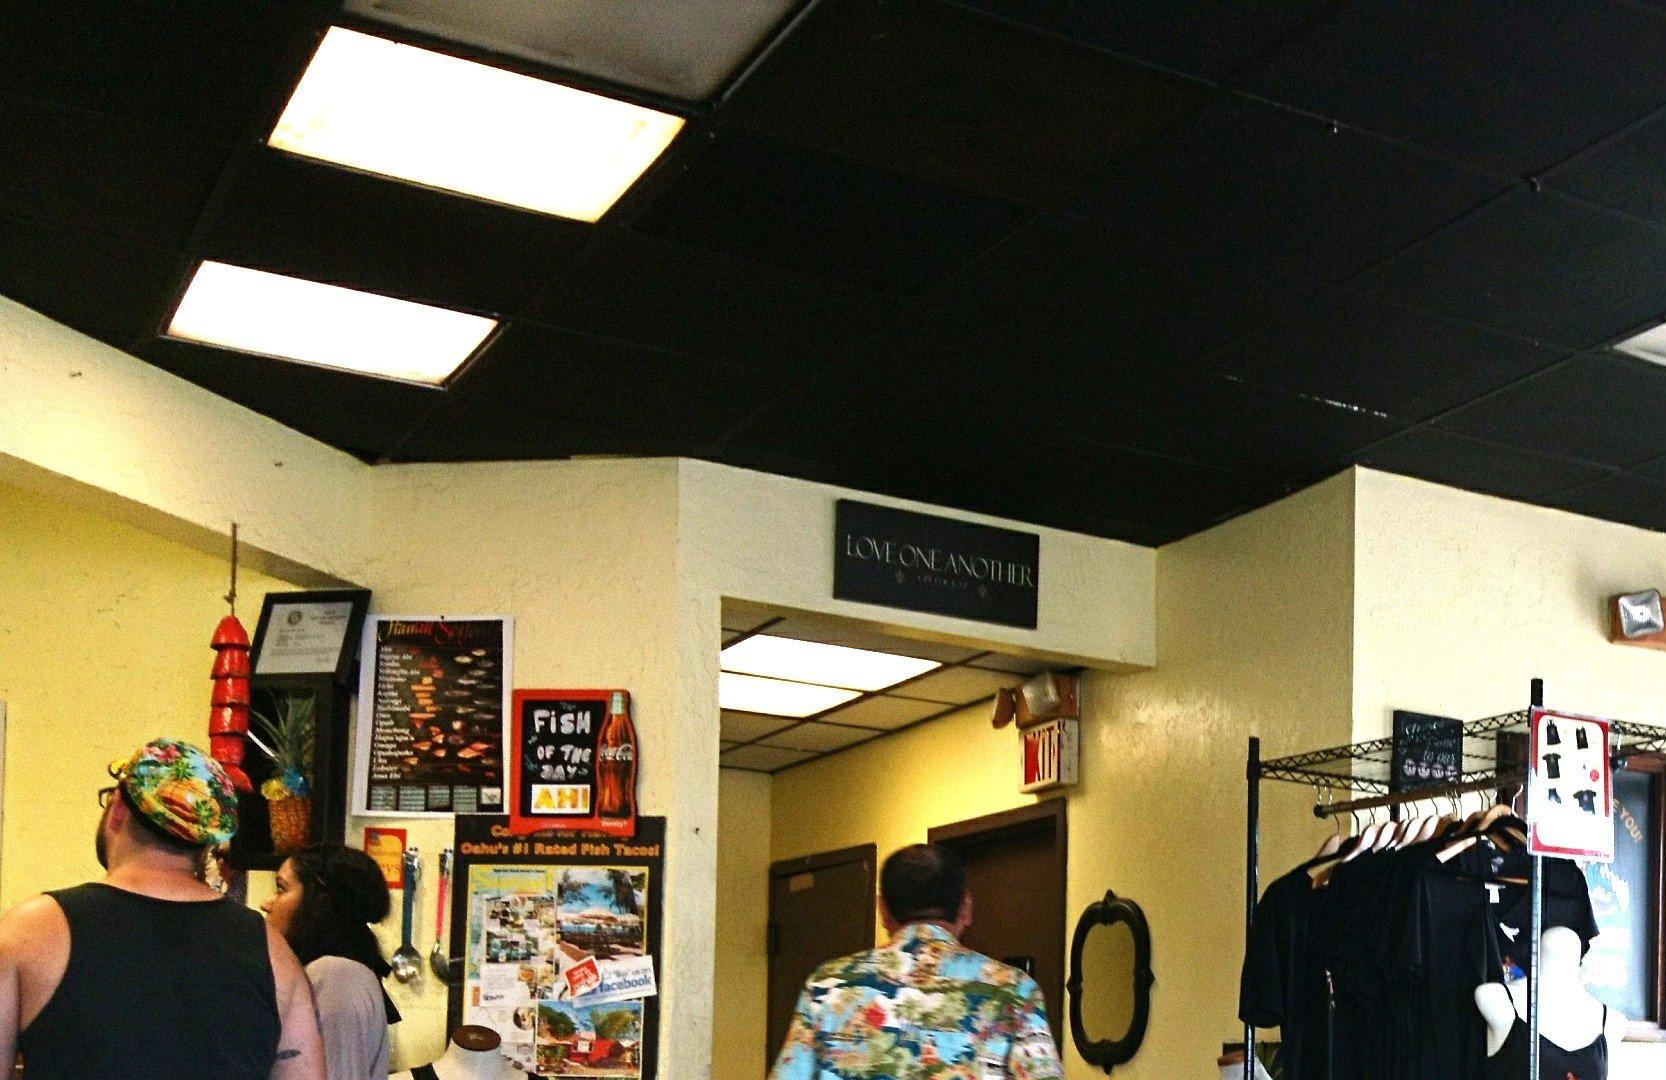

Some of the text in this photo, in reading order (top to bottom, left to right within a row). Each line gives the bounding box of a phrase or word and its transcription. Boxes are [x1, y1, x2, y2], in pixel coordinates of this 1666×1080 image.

[846, 534, 895, 563] LOVE
[899, 544, 942, 571] ONE
[945, 553, 1034, 588] ANOTHER
[536, 744, 555, 761] OF
[540, 764, 578, 781] DAY
[534, 787, 589, 810] AHI
[460, 842, 661, 858] Oahu's #1 Rated Fish Tacos!
[598, 975, 652, 993] facebook
